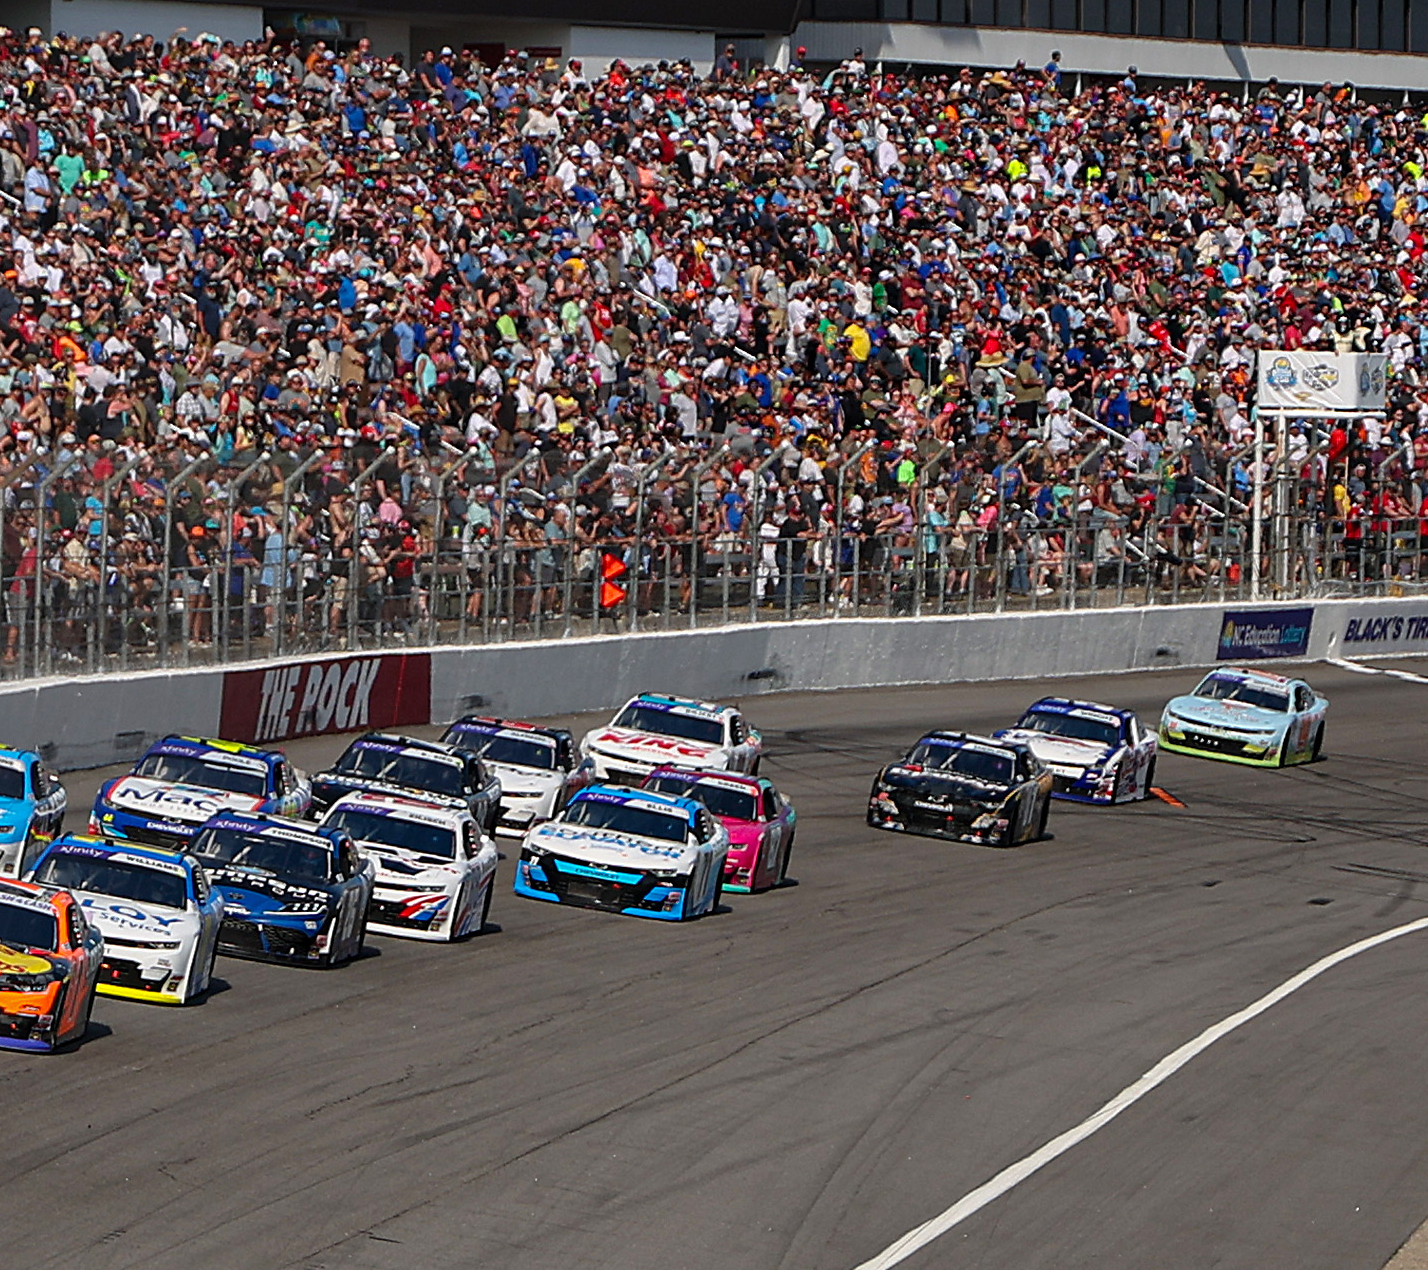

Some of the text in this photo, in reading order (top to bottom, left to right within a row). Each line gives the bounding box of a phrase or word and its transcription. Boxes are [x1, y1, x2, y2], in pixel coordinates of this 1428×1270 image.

[1344, 615, 1404, 644] BLACK'S
[254, 658, 382, 742] THE ROCK
[59, 845, 105, 858] xfinity
[126, 855, 180, 872] WILLIAMS
